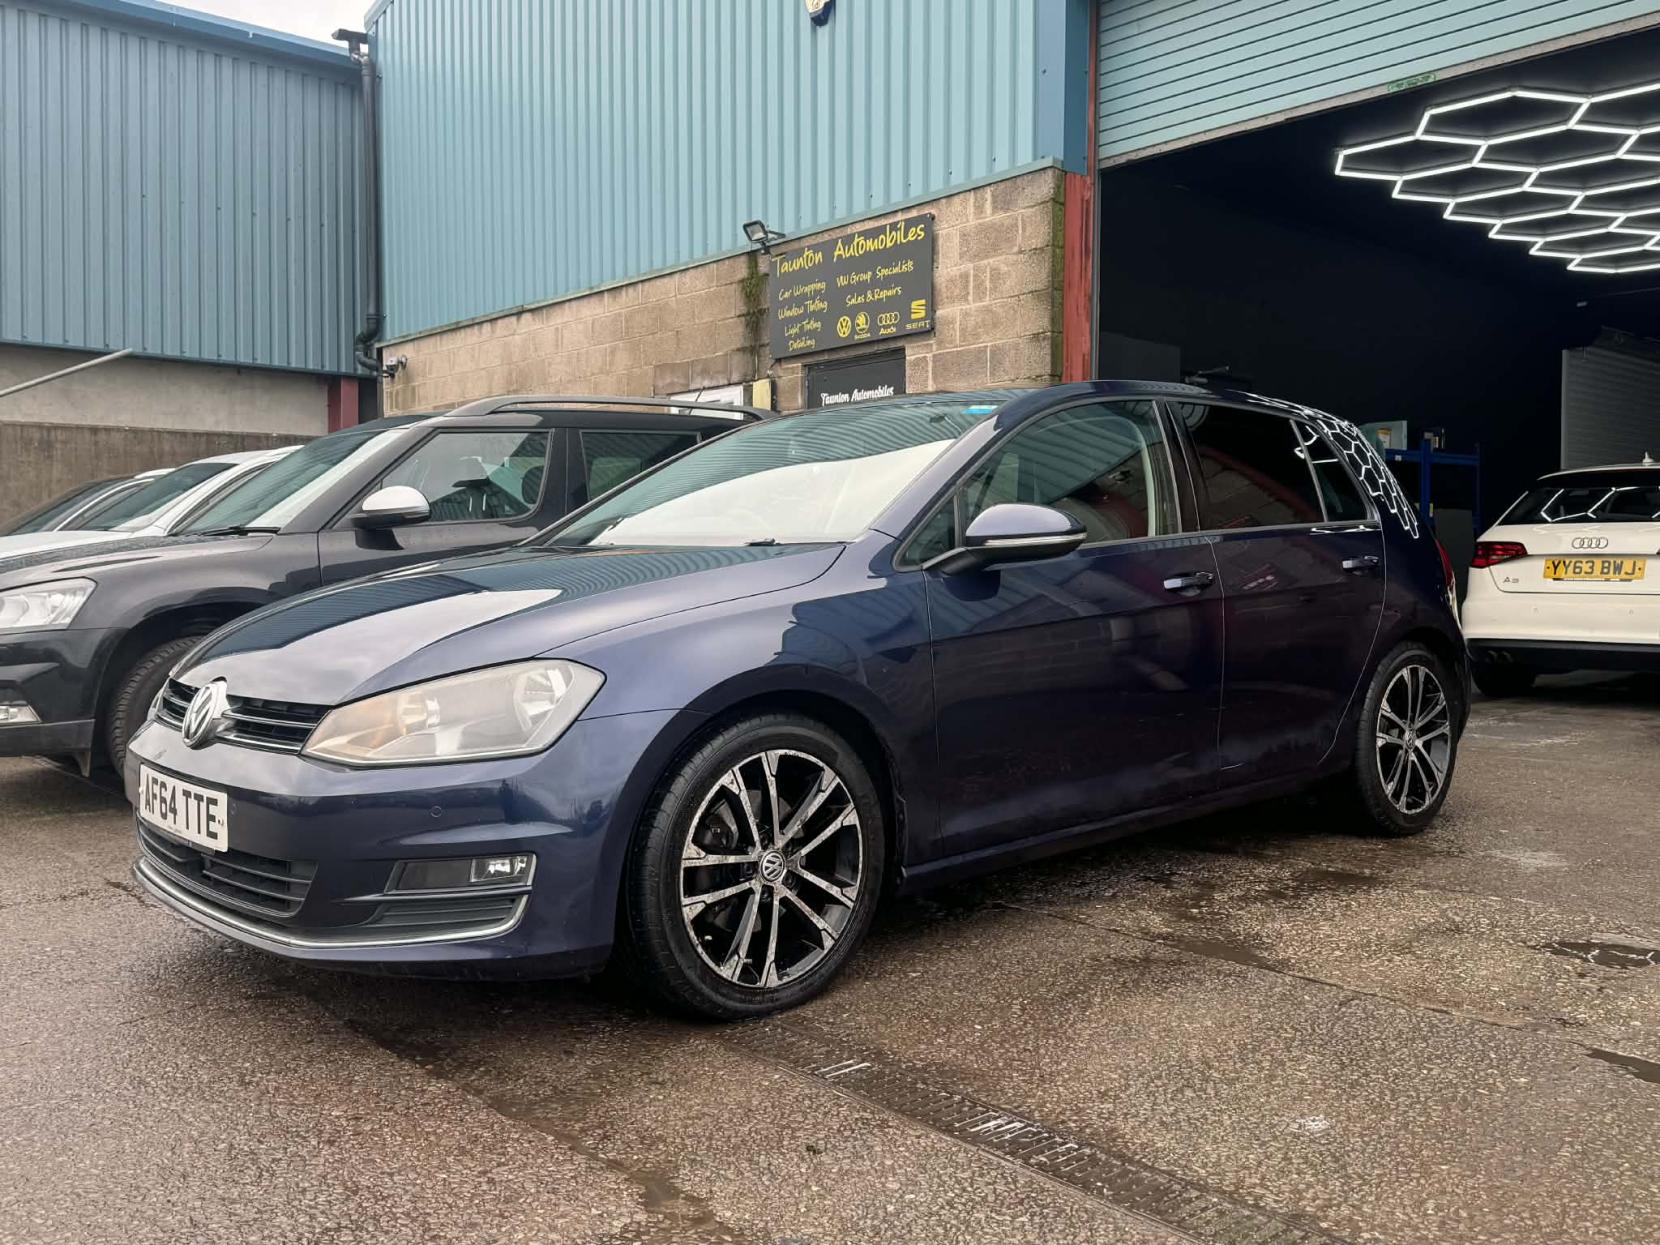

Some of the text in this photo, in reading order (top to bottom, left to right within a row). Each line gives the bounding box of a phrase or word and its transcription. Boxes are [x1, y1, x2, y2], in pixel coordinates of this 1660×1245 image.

[772, 221, 925, 278] Taunton Automobiles
[836, 259, 914, 288] VW Group Specialists
[779, 279, 826, 300] Car Wrapping
[846, 283, 902, 307] Sales & Repairs
[778, 295, 828, 320] Window Tinting
[785, 322, 801, 337] Light
[879, 326, 897, 335] Audi
[905, 320, 931, 330] SEAT
[820, 384, 894, 407] Taunton Automobiles
[1552, 560, 1636, 576] YY63 BWJ
[145, 773, 218, 840] AF64 TTE
